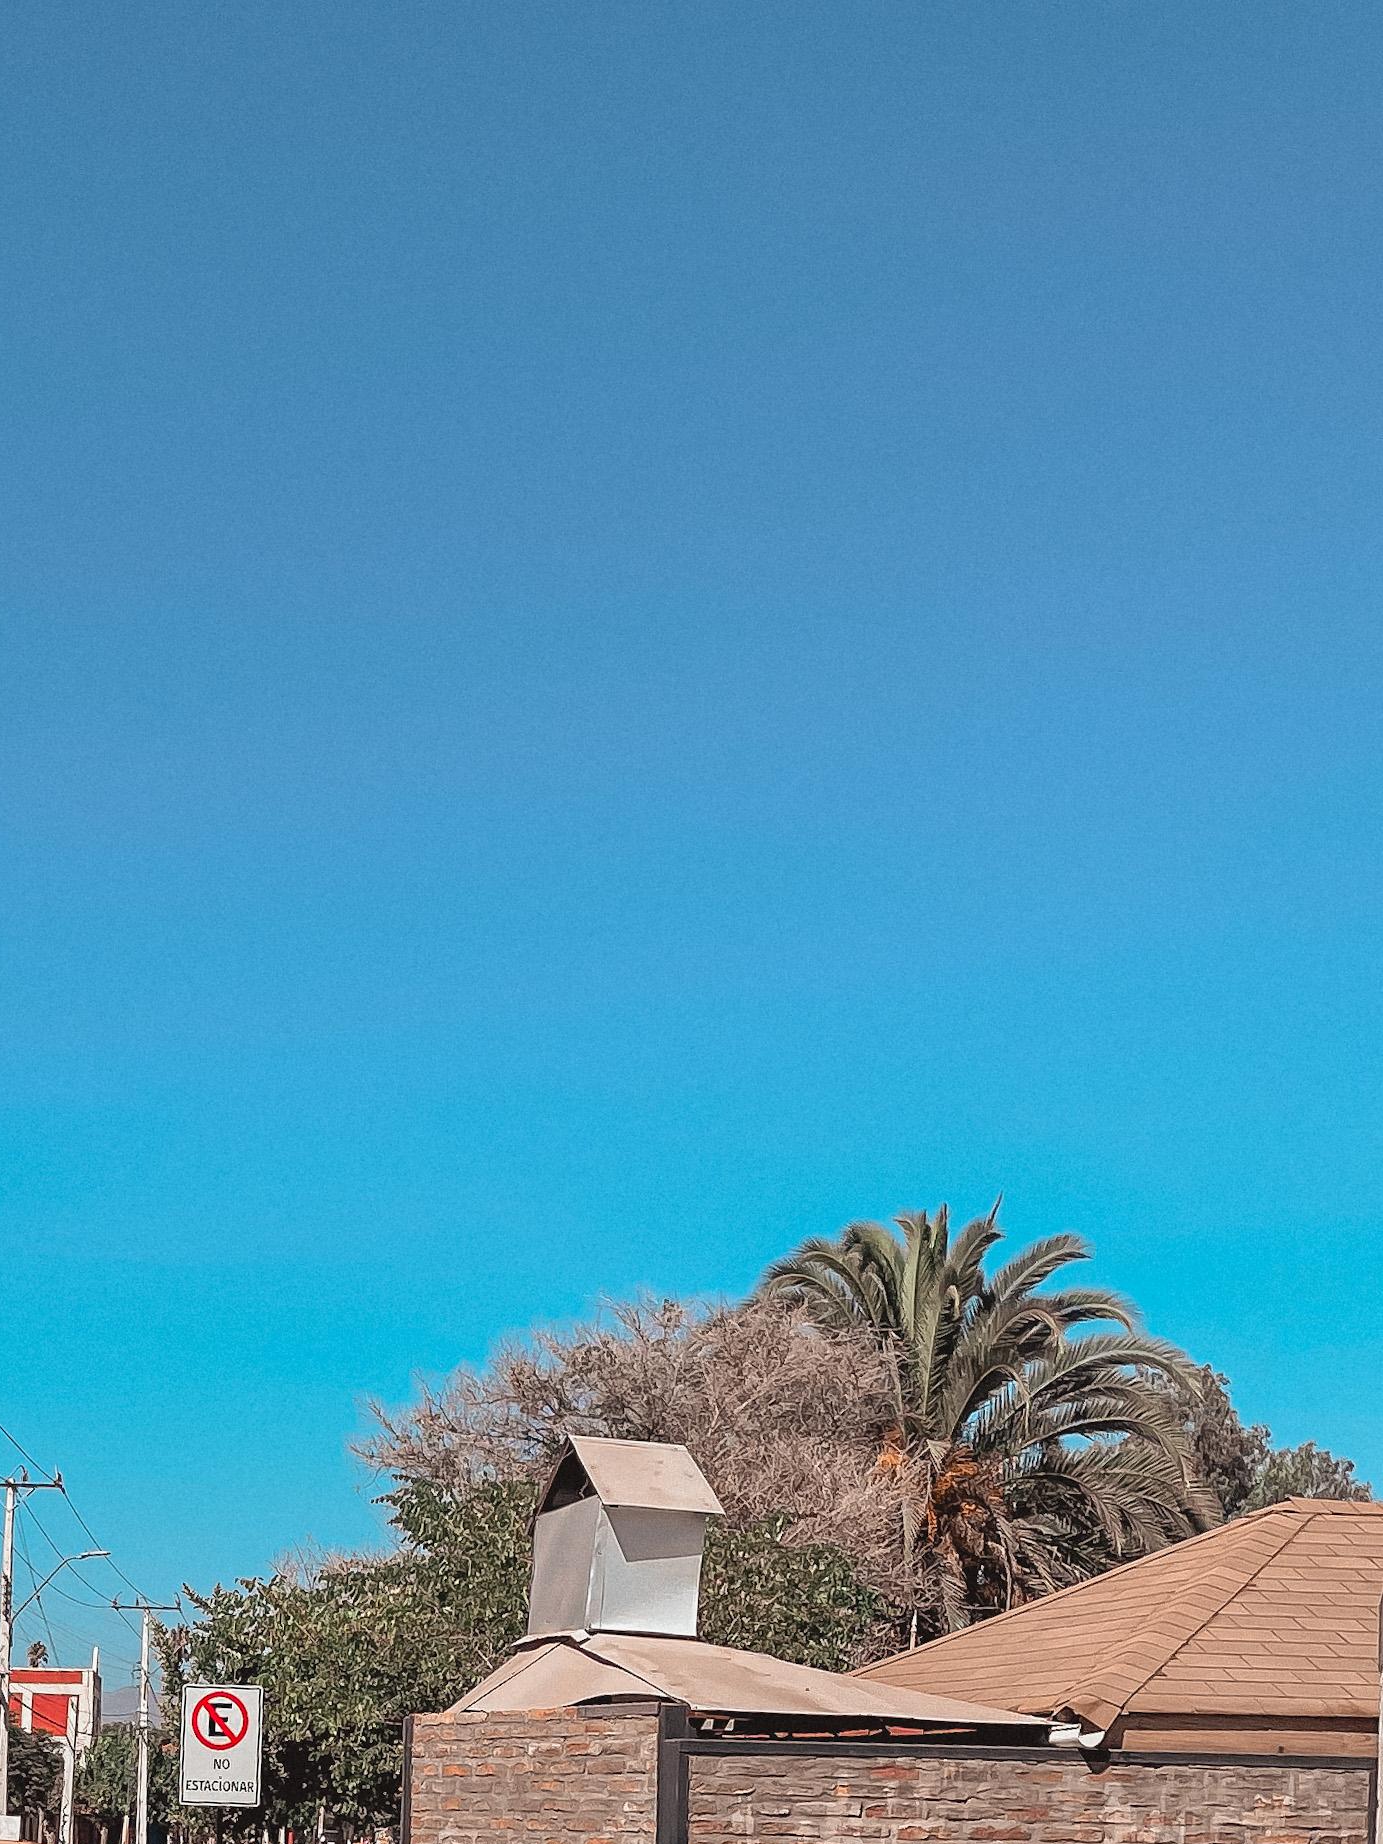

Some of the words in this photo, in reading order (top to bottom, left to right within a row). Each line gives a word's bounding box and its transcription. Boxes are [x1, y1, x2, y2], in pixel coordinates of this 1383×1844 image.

[208, 1703, 232, 1737] E
[213, 1758, 230, 1770] NO
[185, 1780, 254, 1793] ESTACIONAR
